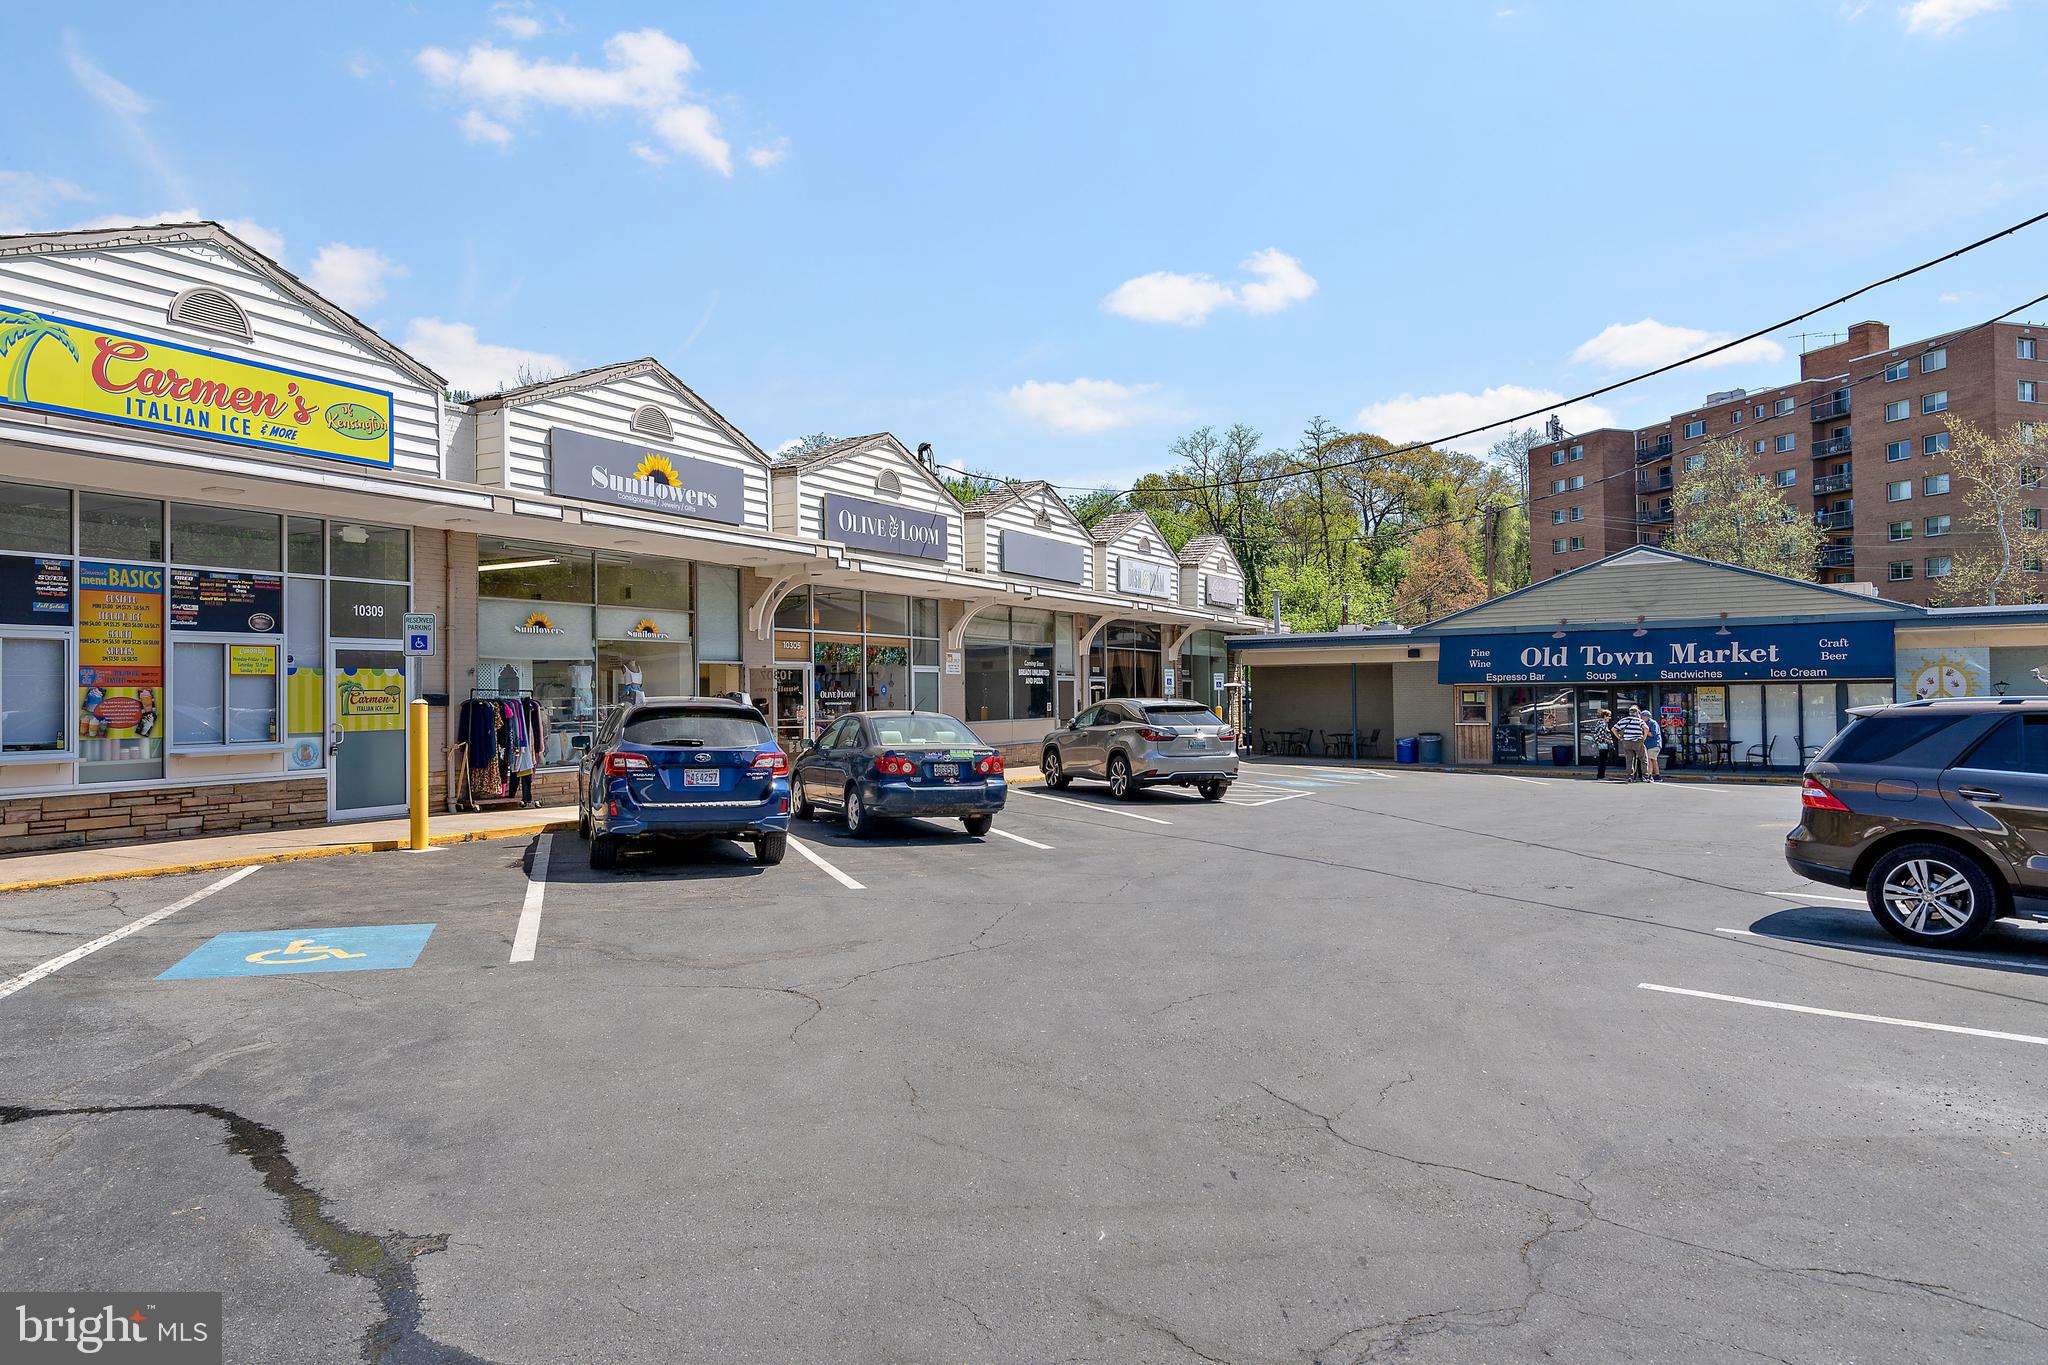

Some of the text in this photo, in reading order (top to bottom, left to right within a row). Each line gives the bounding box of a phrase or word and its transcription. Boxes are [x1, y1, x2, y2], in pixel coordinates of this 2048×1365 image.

[91, 336, 319, 425] Carmen's
[341, 403, 353, 417] of
[125, 396, 298, 440] ITALIAN ICE & MORE
[327, 411, 388, 434] Kensington
[591, 464, 718, 509] Sunflowers
[617, 492, 657, 507] Consignments
[661, 501, 681, 511] Jewelry
[684, 504, 697, 512] Gifts
[838, 509, 887, 537] OLIVE
[900, 520, 939, 545] LOOM
[80, 567, 161, 589] menu BASICS
[353, 604, 384, 617] 10309
[514, 624, 565, 635] Sunflowers
[627, 630, 670, 639] Sunflowers
[783, 641, 801, 649] 10305
[1818, 638, 1849, 648] Craft
[1470, 649, 1490, 657] Fine
[1520, 641, 1780, 667] Old Town Market
[1820, 651, 1848, 661] Beer
[1469, 659, 1491, 668] Wine
[1486, 667, 1828, 682] Espresso Bar Soups Sandwiches Ice Cream
[350, 691, 398, 704] Carmen's
[820, 690, 836, 699] OLIVE
[1660, 717, 1685, 727] OPEN
